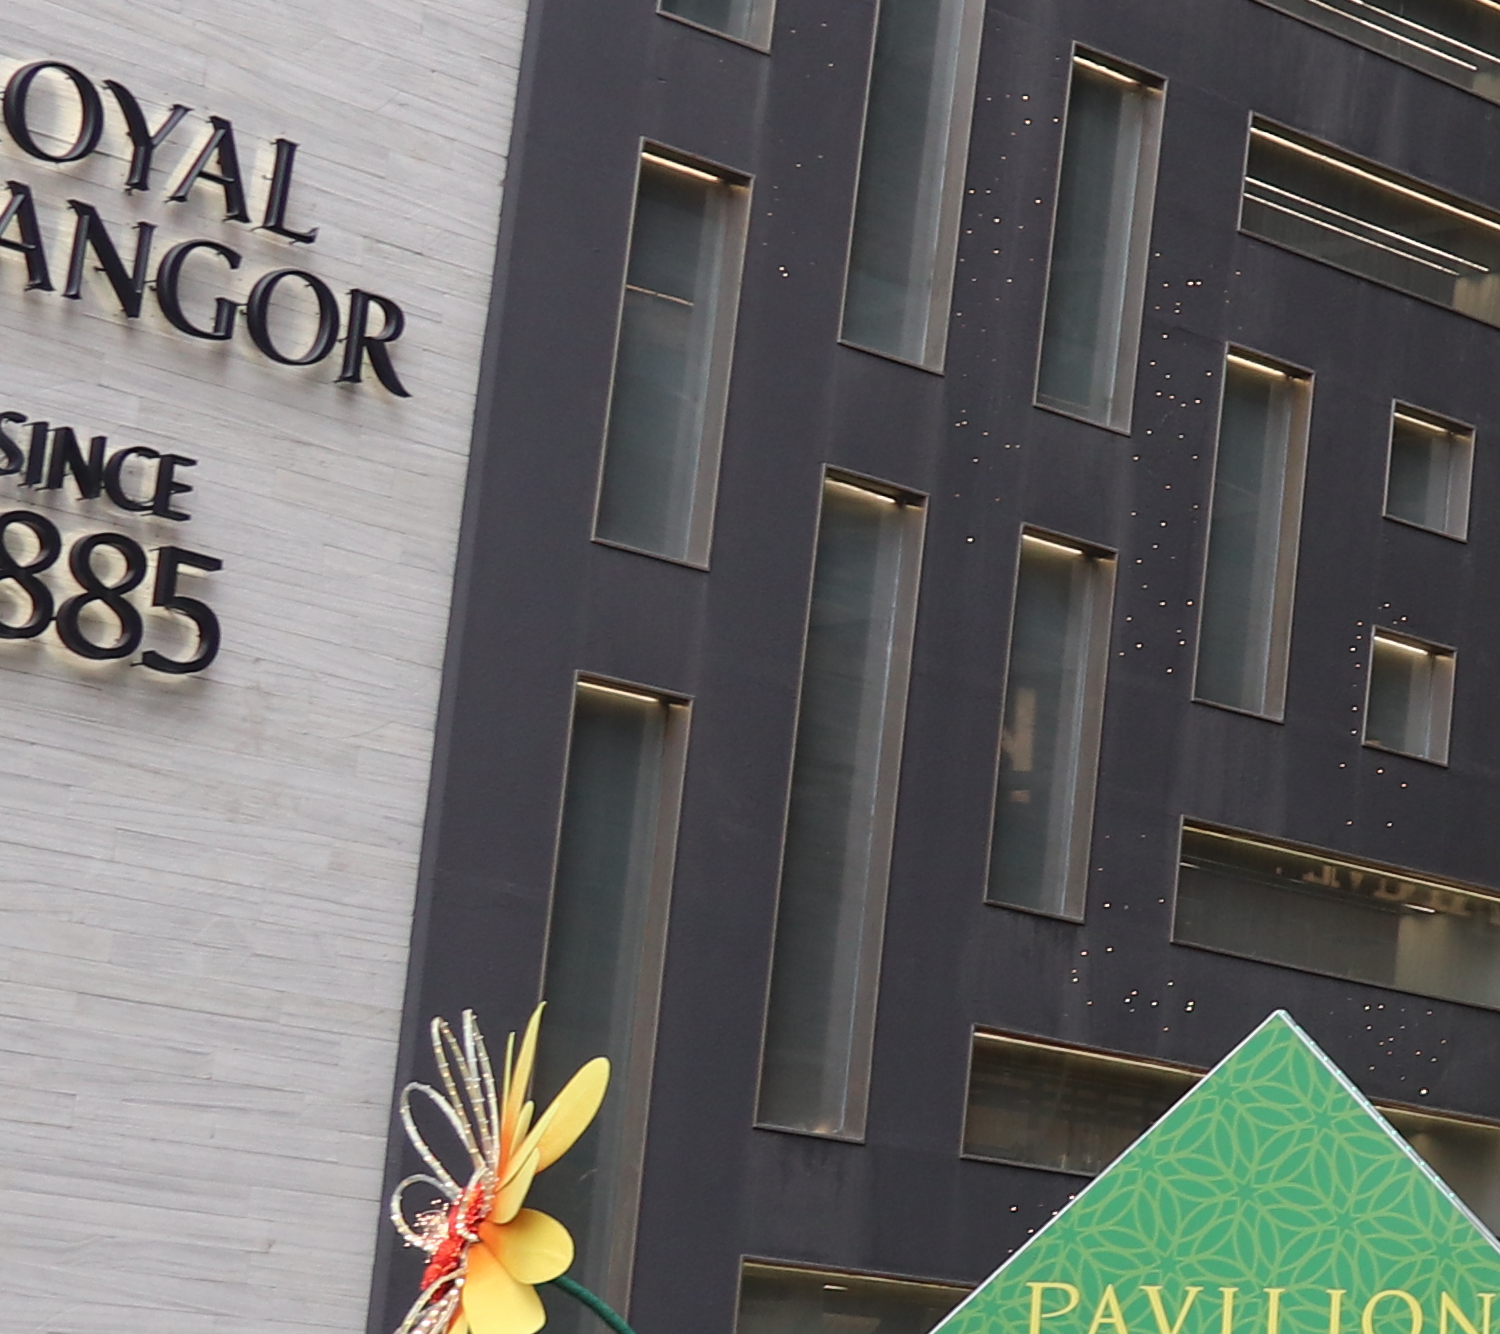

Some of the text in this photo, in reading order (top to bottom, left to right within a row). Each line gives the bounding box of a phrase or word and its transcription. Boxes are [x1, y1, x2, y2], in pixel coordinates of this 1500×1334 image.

[3, 61, 319, 243] OYAL
[0, 411, 197, 521] SINCE
[0, 510, 223, 674] 885
